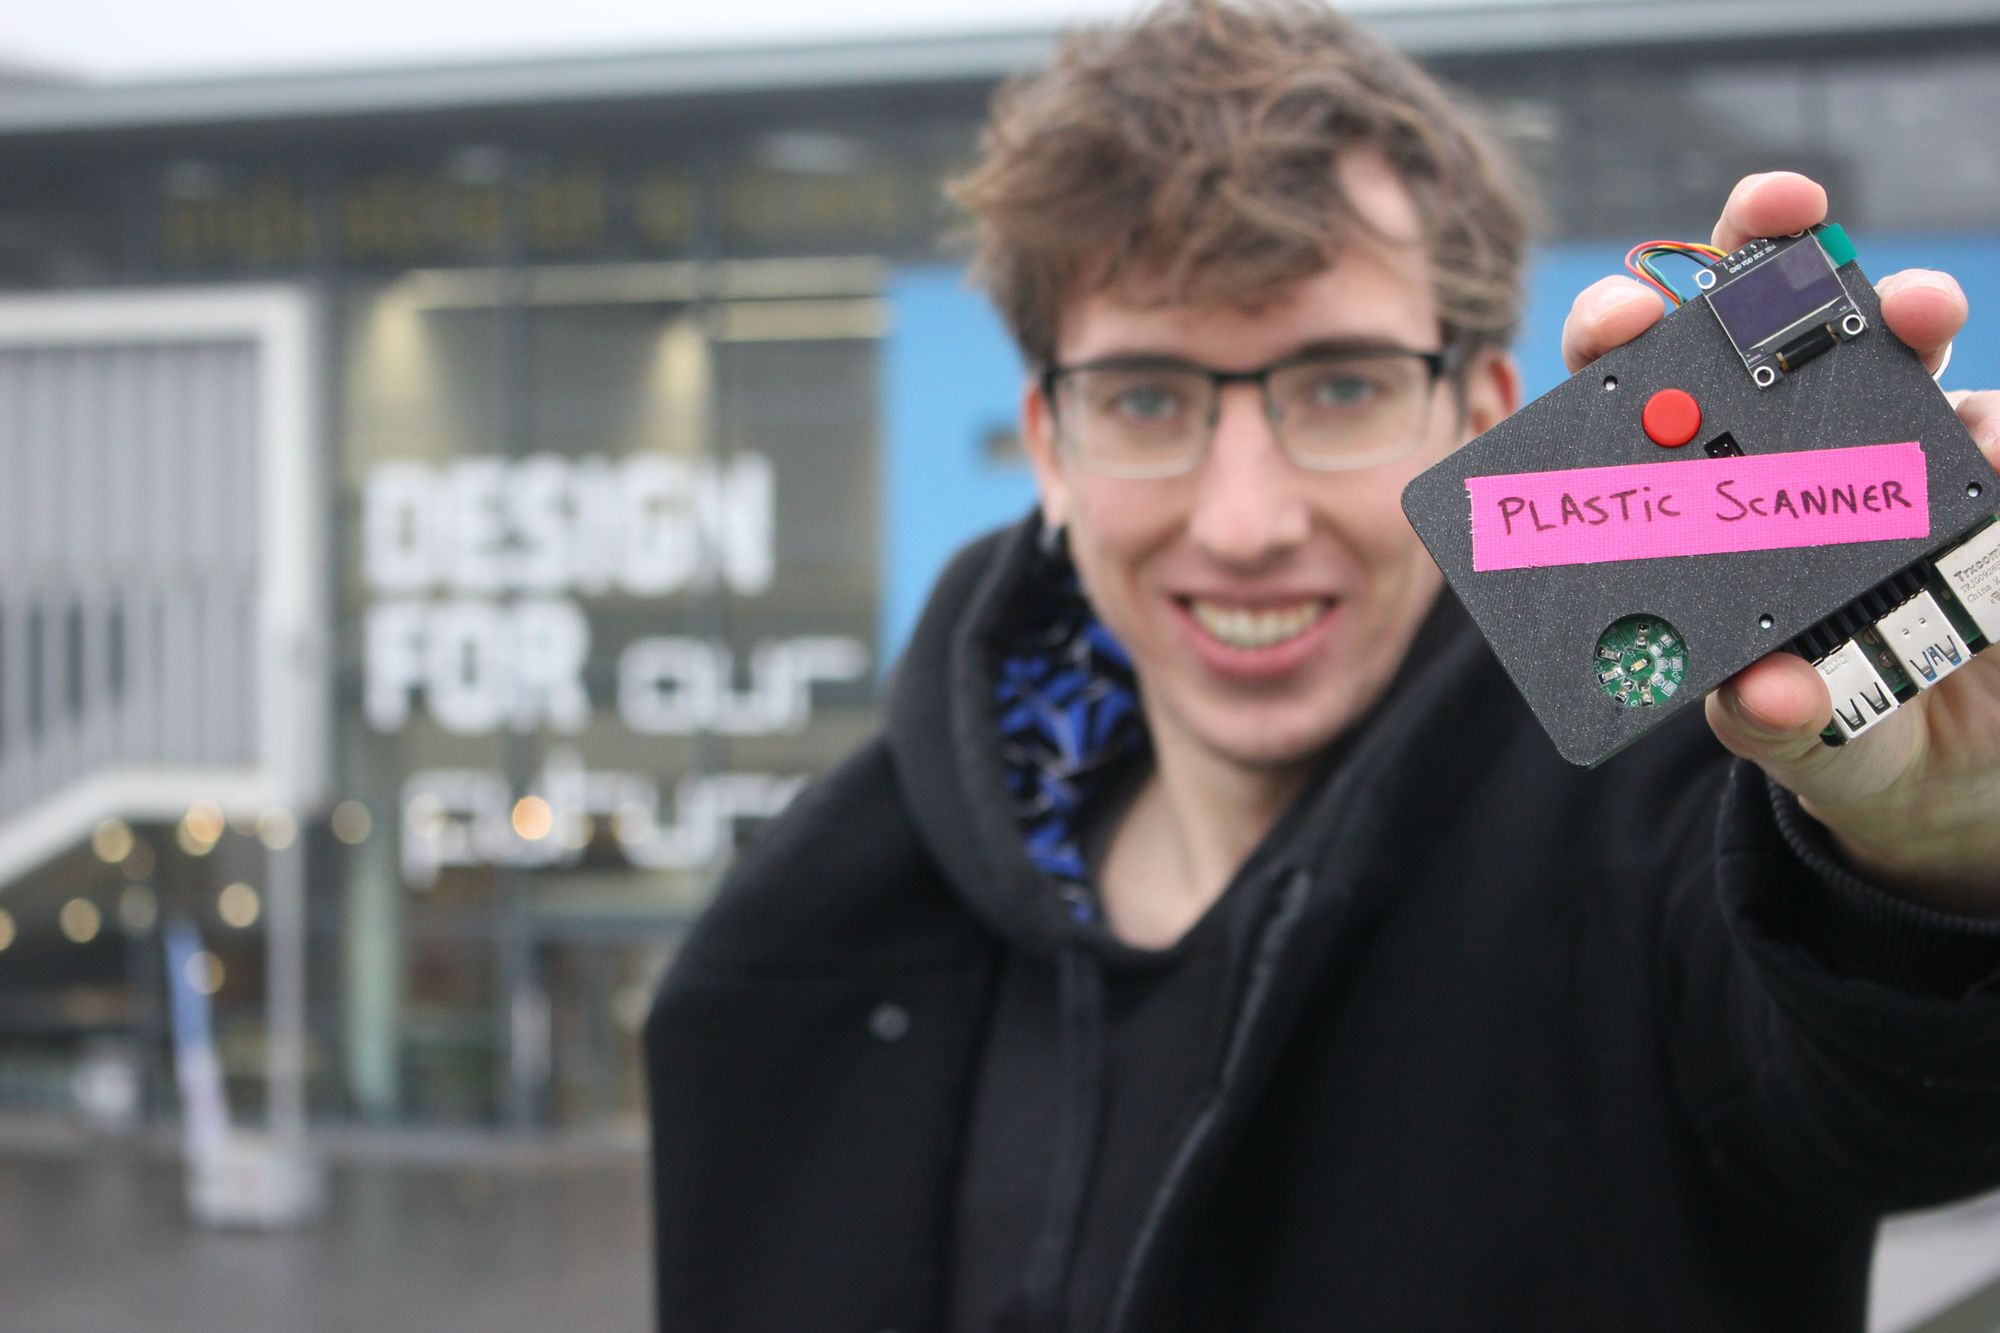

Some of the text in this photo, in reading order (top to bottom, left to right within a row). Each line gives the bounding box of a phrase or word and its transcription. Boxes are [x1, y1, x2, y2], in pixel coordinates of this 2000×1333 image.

[363, 452, 775, 595] DESIGN
[1967, 584, 1992, 603] China
[362, 600, 870, 735] FOR our
